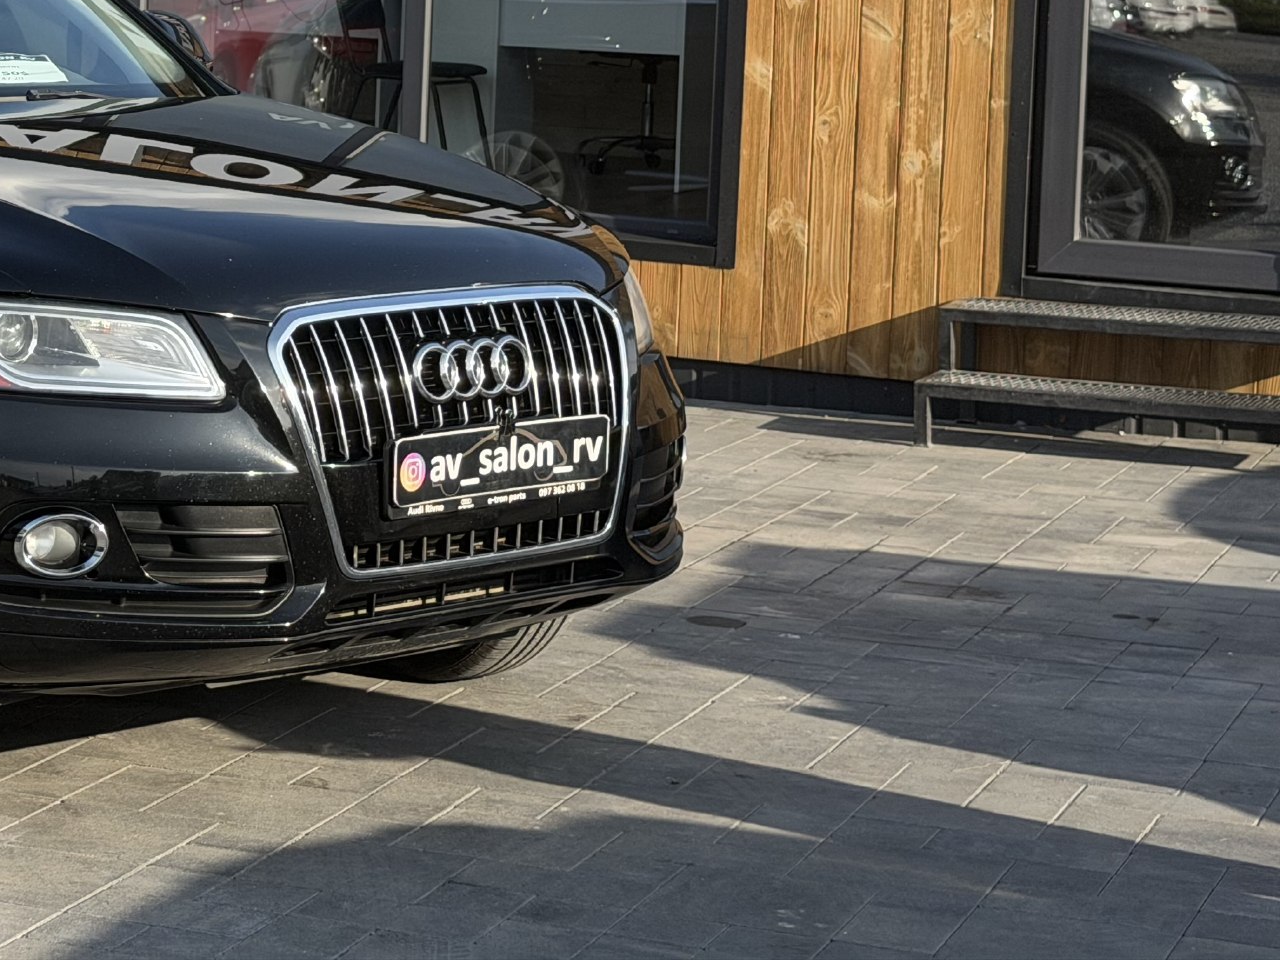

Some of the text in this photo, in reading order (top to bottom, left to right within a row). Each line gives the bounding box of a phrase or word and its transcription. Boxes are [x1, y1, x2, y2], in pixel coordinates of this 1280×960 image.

[430, 435, 604, 487] av_salon_rv
[487, 492, 527, 505] e-tron parts
[407, 505, 424, 516] Audi
